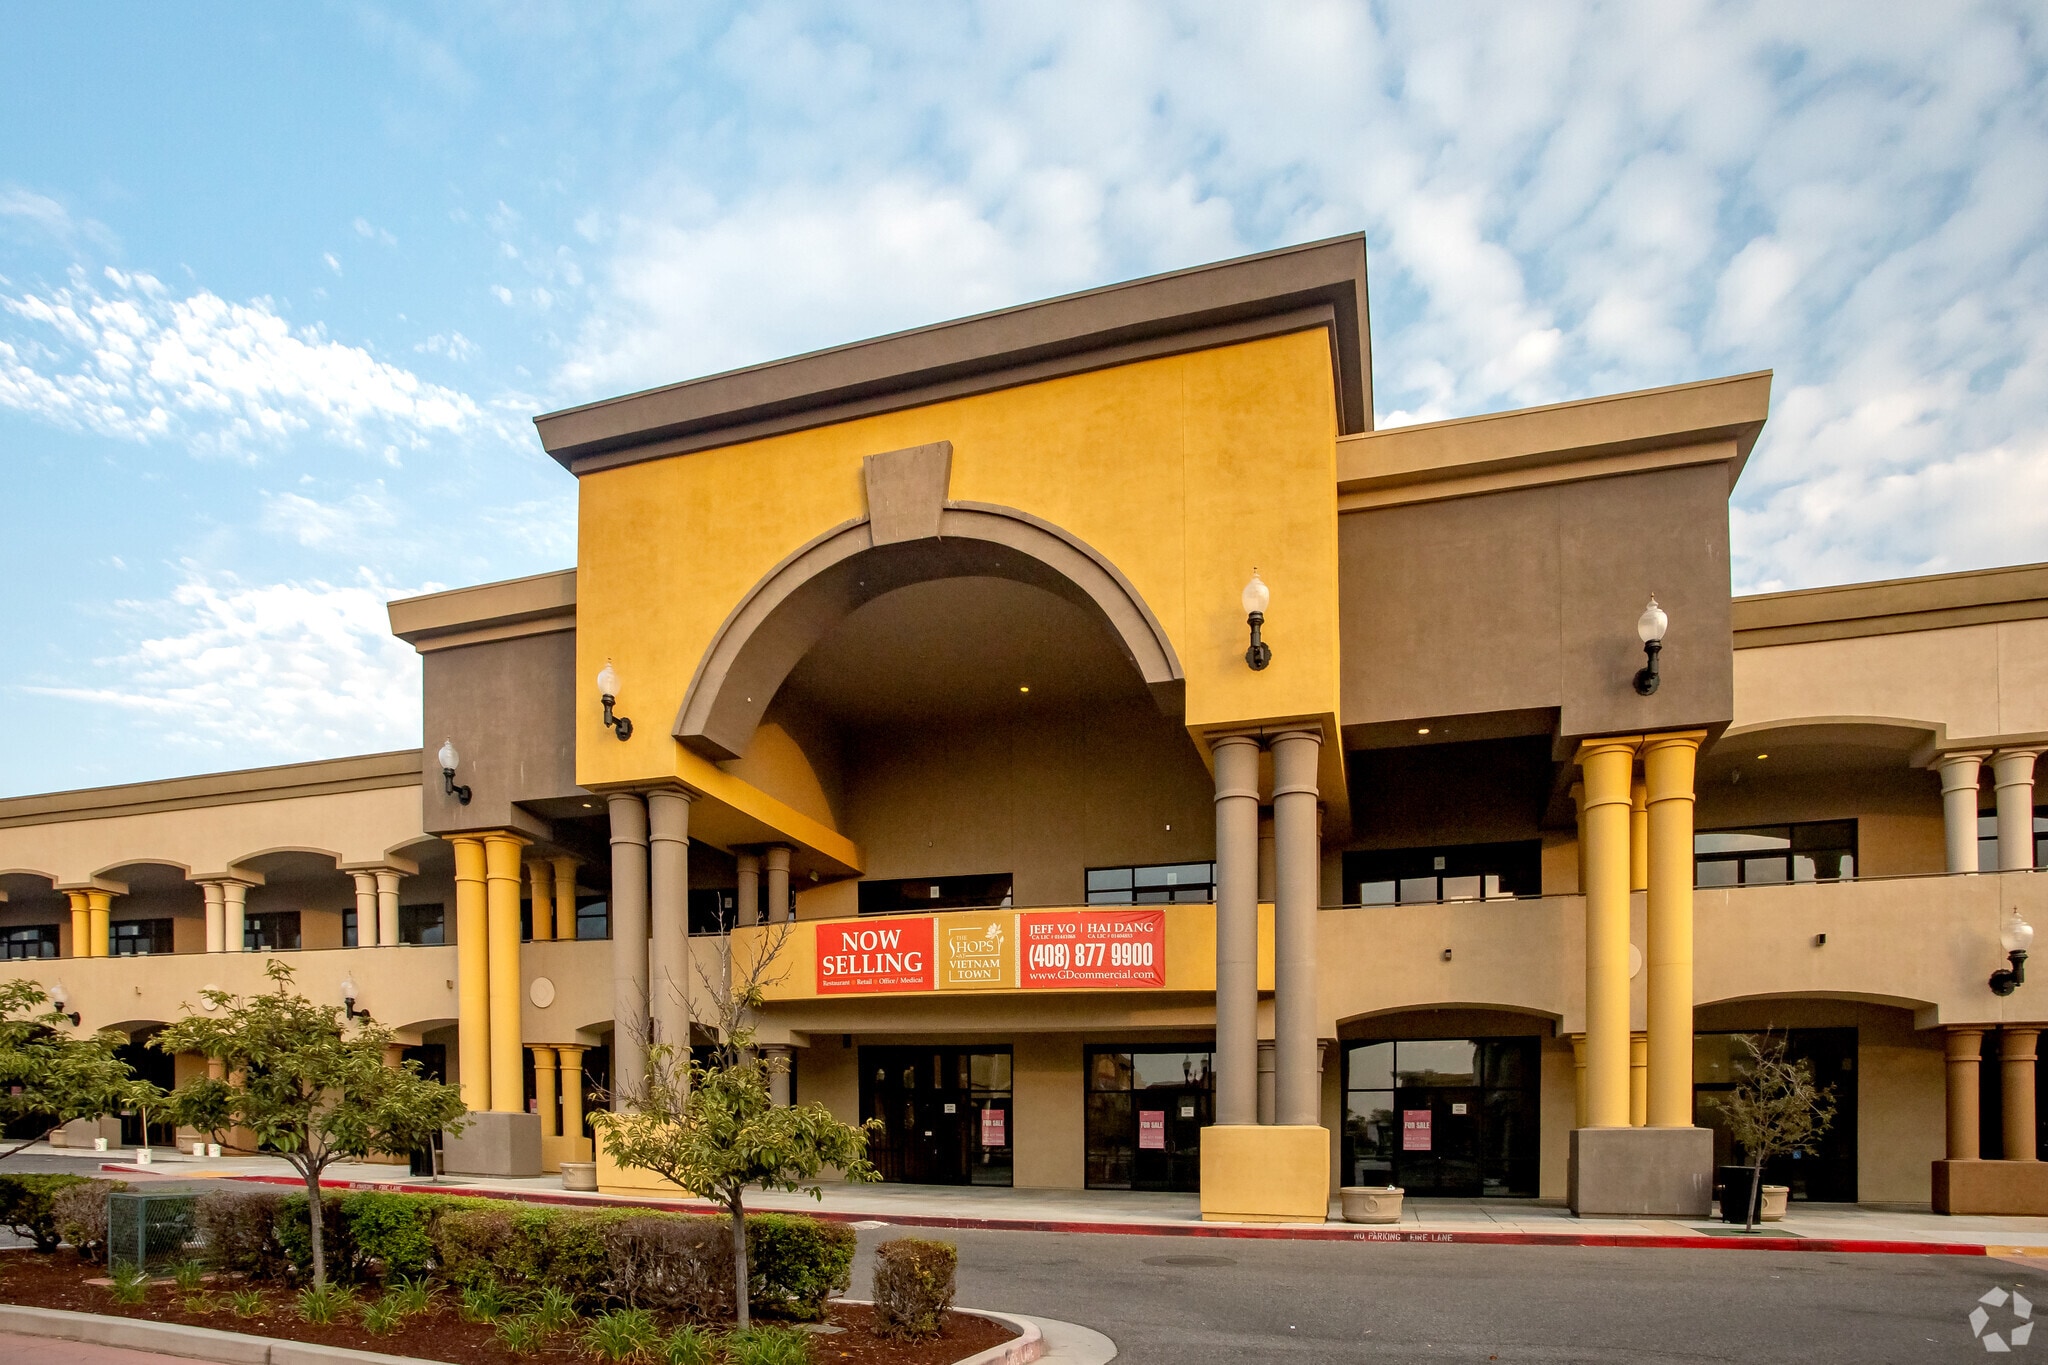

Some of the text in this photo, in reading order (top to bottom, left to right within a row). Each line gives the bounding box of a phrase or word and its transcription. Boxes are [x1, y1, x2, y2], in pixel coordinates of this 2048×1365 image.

[1029, 923, 1076, 936] JEFF VO
[1088, 922, 1154, 933] HAI DANG
[842, 929, 902, 952] NOW
[950, 937, 994, 958] SHOPS
[1029, 942, 1154, 970] (408) 877 9900
[822, 952, 923, 976] SELLING
[950, 959, 1000, 969] VIETNAM
[958, 970, 991, 978] TOWN
[1029, 970, 1155, 980] www.GDcommercial.com
[1368, 1232, 1400, 1241] PARKING
[1432, 1234, 1453, 1242] LANE
